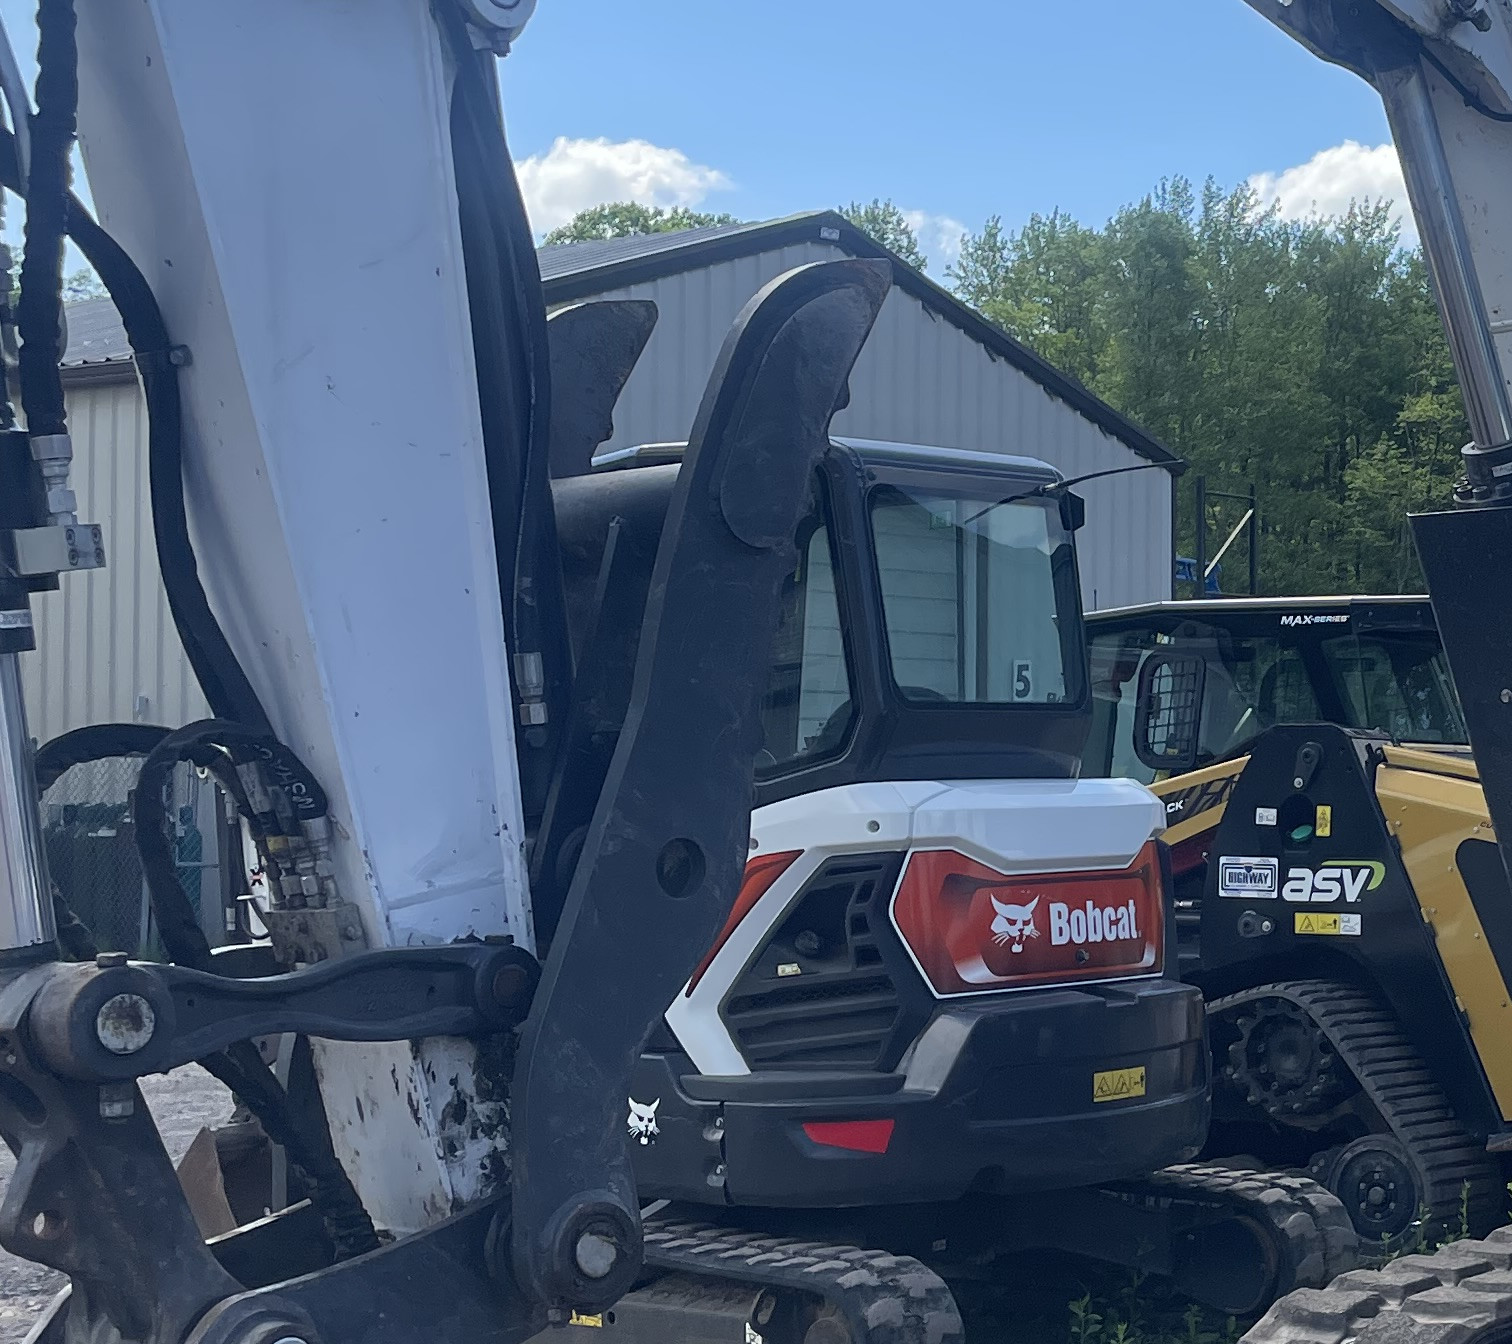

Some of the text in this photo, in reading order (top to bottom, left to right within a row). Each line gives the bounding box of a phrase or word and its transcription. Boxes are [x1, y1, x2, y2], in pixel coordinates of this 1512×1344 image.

[1015, 664, 1031, 698] 5
[1228, 871, 1270, 885] HIGHWAY
[1049, 899, 1138, 946] Bobcat
